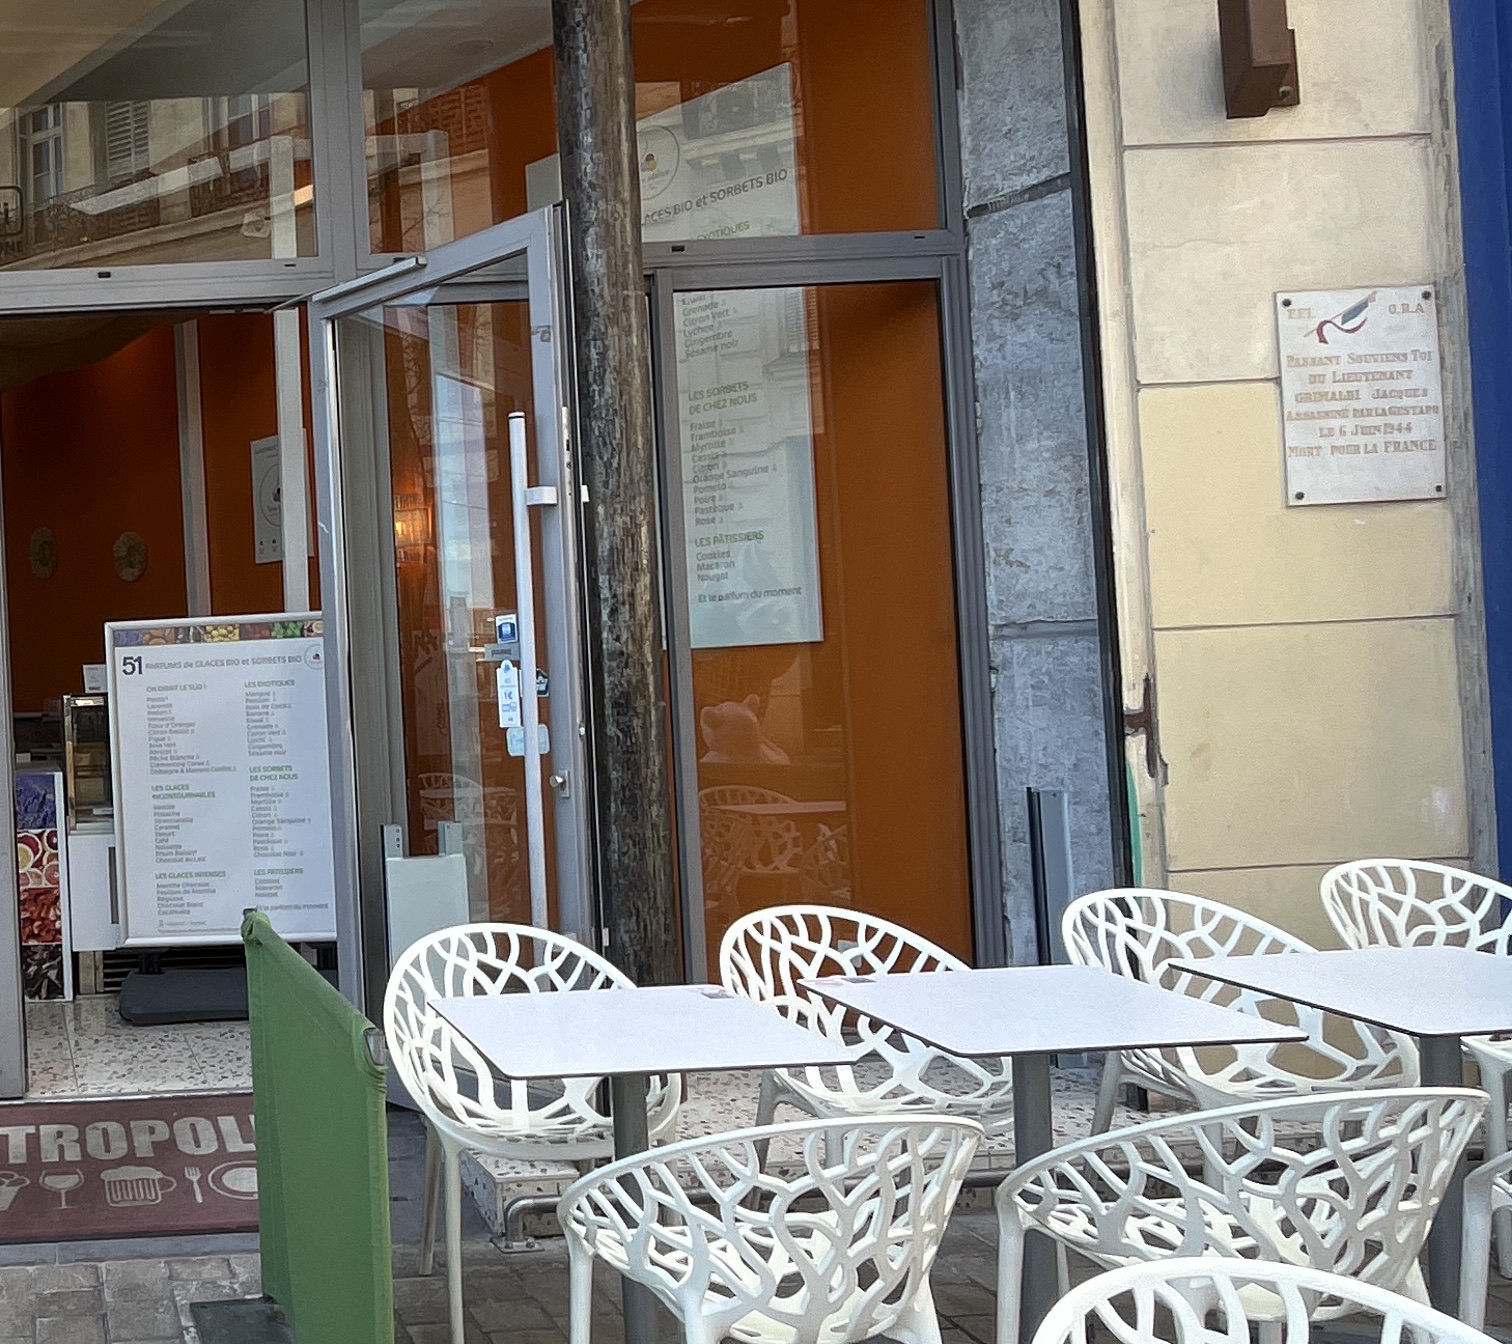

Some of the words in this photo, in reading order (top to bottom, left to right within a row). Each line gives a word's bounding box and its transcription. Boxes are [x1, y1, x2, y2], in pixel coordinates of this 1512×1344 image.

[673, 200, 693, 216] BIO
[695, 194, 708, 208] et
[709, 176, 764, 203] SORBETS
[766, 169, 788, 185] BIO
[688, 390, 705, 402] LES
[706, 381, 749, 398] SORBETS
[689, 403, 701, 415] DE
[702, 399, 728, 412] CHEZ
[729, 392, 757, 407] NOUS
[690, 421, 716, 431] Fraise
[691, 427, 737, 441] Framboise
[1384, 439, 1436, 453] FRANCE
[695, 537, 711, 548] LES
[713, 530, 765, 545] PÂTISSIERS
[750, 589, 762, 599] du
[763, 586, 802, 598] moment
[122, 656, 142, 675] 51
